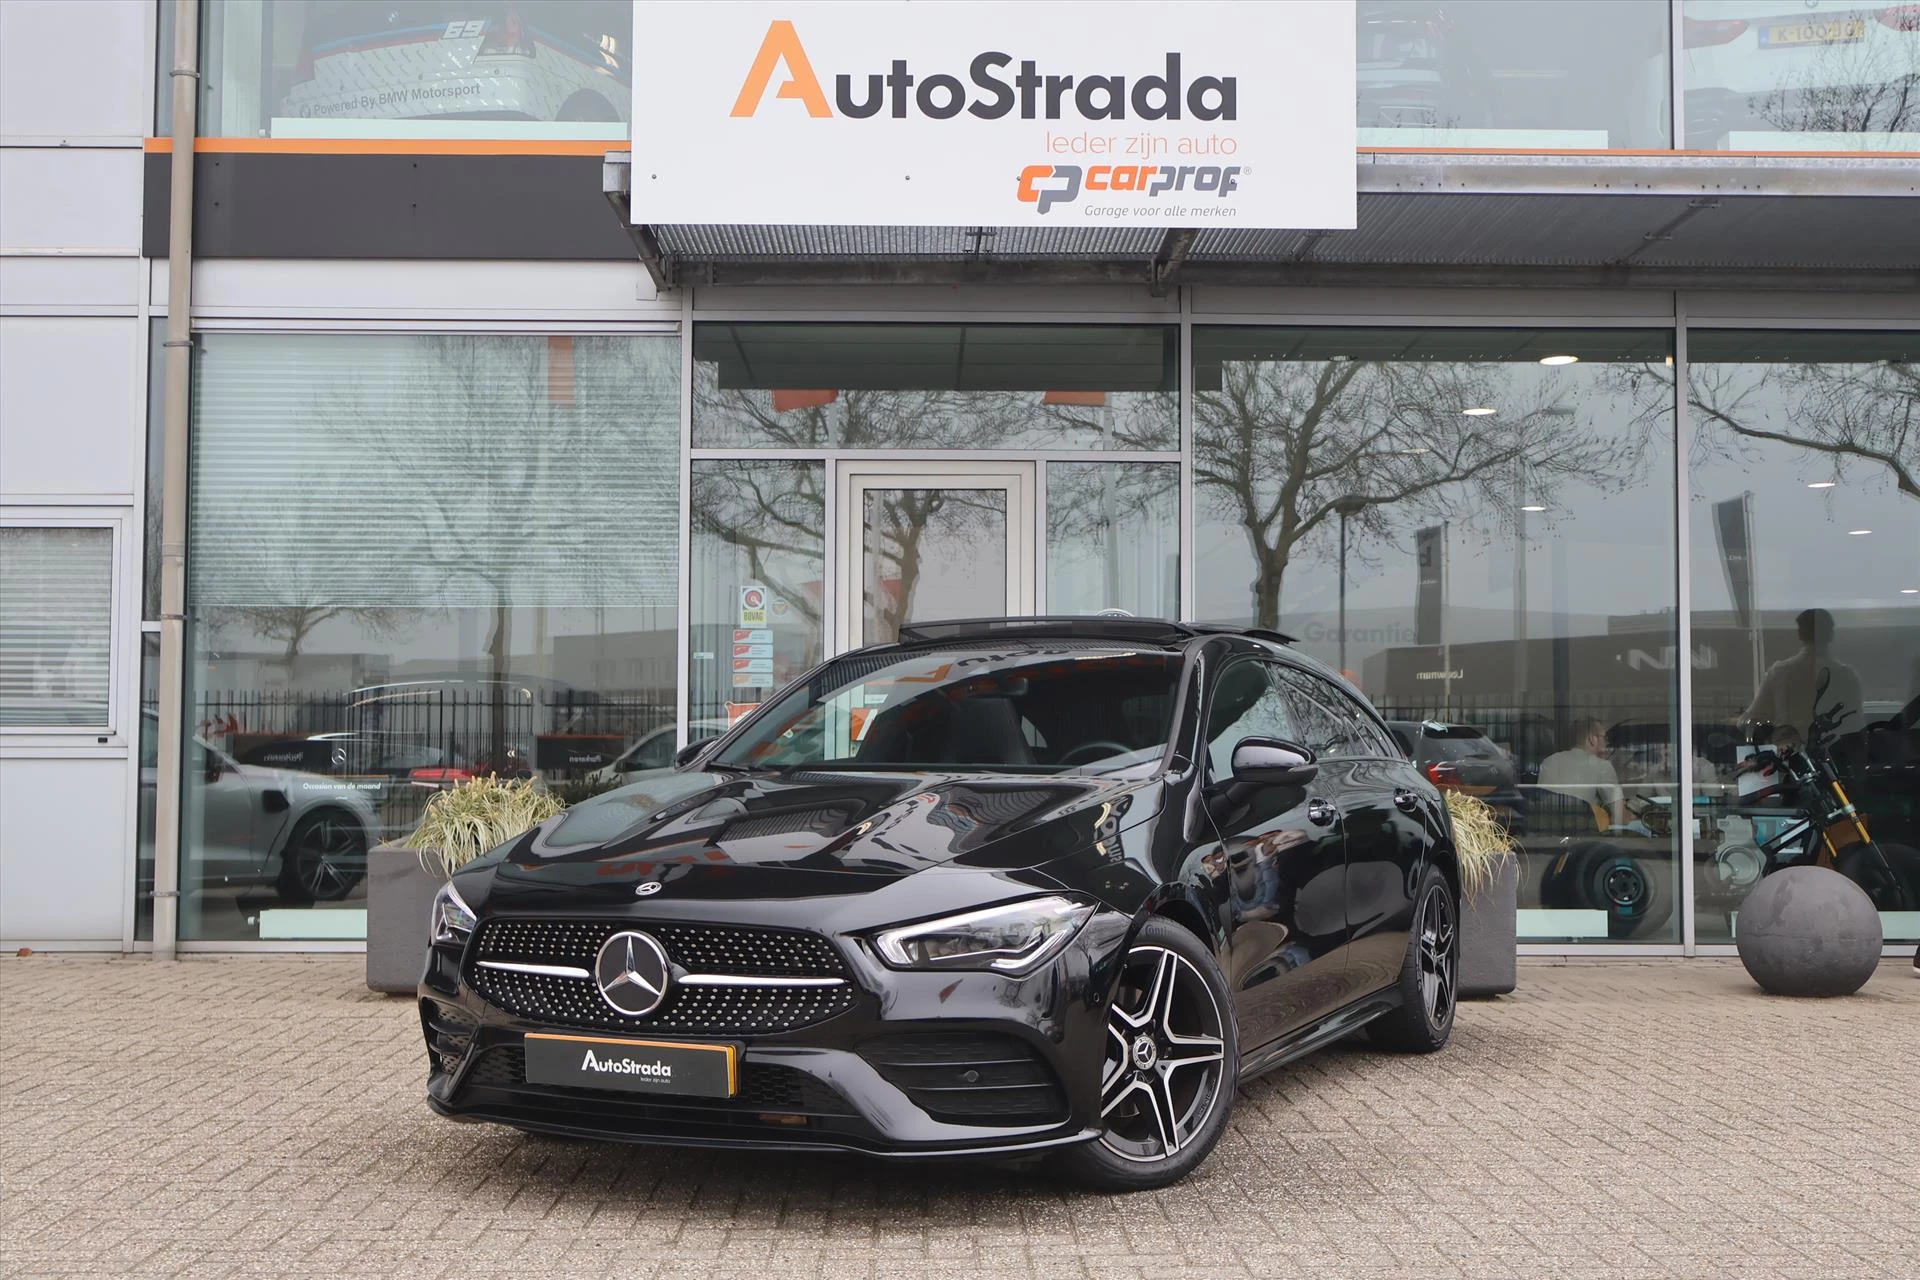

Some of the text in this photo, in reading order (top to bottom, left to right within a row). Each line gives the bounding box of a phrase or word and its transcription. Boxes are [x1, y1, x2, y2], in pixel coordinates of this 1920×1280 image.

[729, 19, 1238, 121] AutoStrada
[314, 82, 481, 115] Powered By BMW Motorsport
[1125, 131, 1169, 160] zijn
[1178, 136, 1238, 156] auto
[1084, 204, 1237, 218] Garage voor alle merken
[743, 611, 764, 622] BOVAG
[302, 782, 333, 790] Occasion
[347, 782, 356, 790] de
[357, 782, 382, 790] maand
[581, 1049, 671, 1077] AutoStrada
